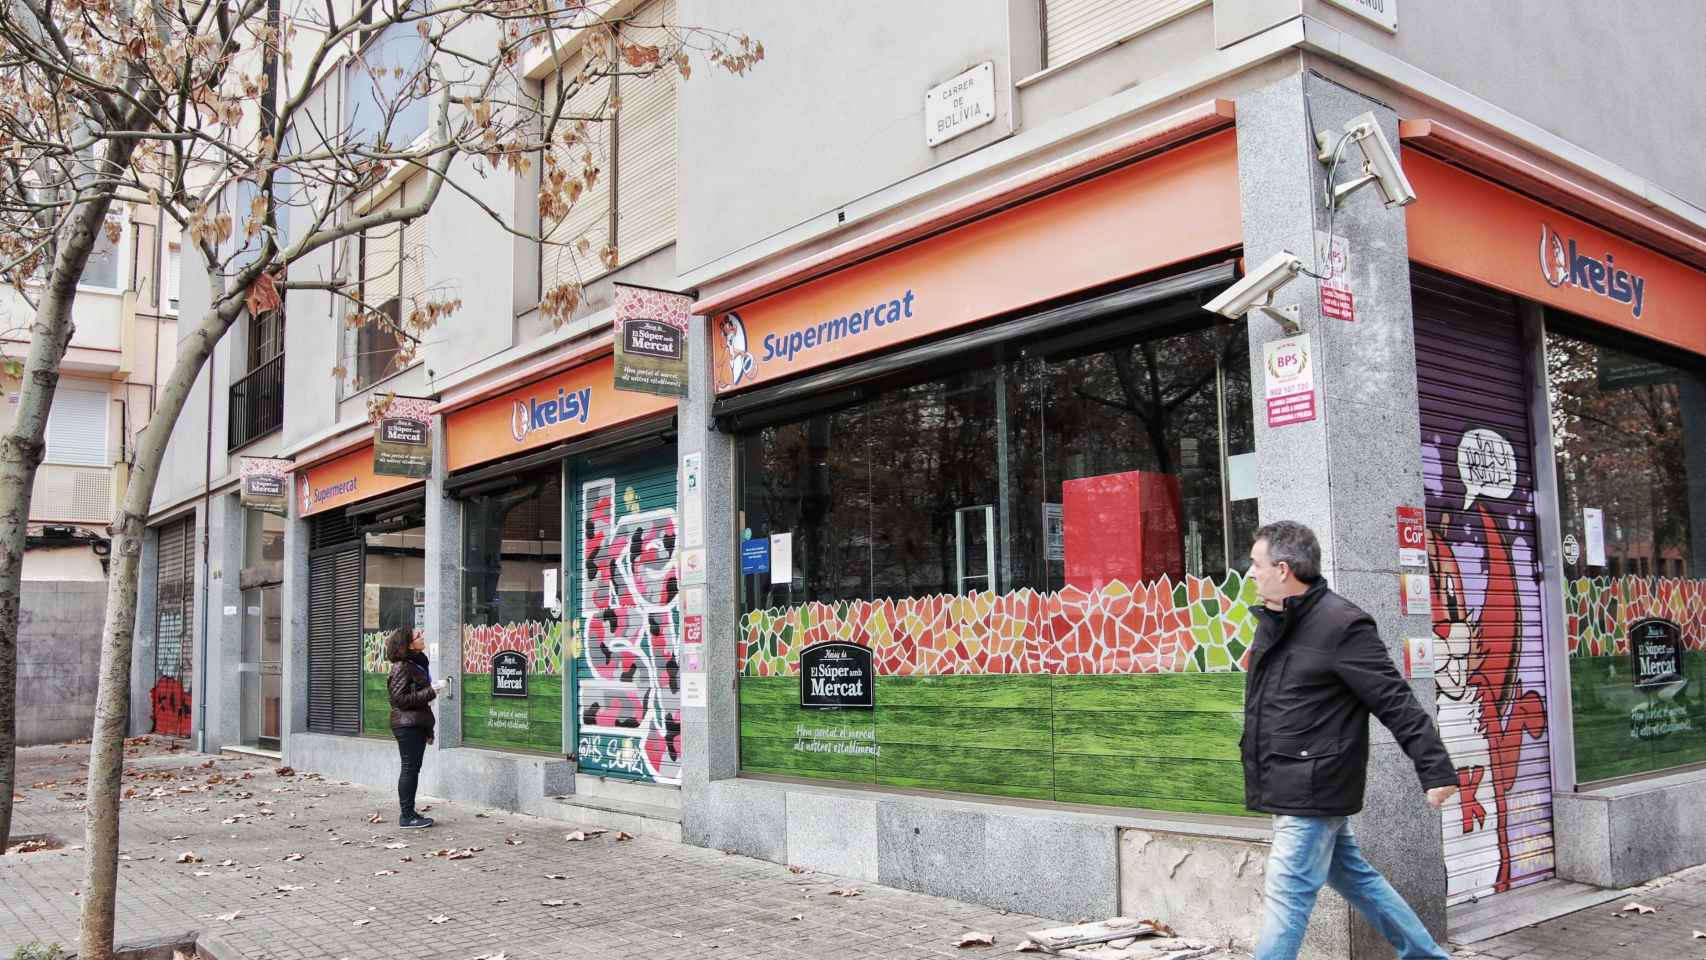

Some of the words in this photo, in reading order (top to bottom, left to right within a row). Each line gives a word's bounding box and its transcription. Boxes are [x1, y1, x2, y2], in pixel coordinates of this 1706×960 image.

[942, 78, 974, 100] CARRER
[953, 97, 964, 108] DE
[1567, 238, 1645, 319] keisy
[762, 289, 914, 362] Supermercat
[632, 337, 674, 352] Mercat
[639, 330, 663, 341] Súper
[1277, 354, 1297, 368] BPS
[530, 385, 592, 432] keisy
[315, 476, 357, 503] Supermercat
[1404, 526, 1424, 544] Cor
[810, 666, 818, 677] El
[818, 663, 849, 681] Súper
[1640, 656, 1676, 676] Mercat
[496, 676, 522, 689] Mercat
[810, 678, 863, 697] Mercat
[1456, 765, 1487, 834] K
